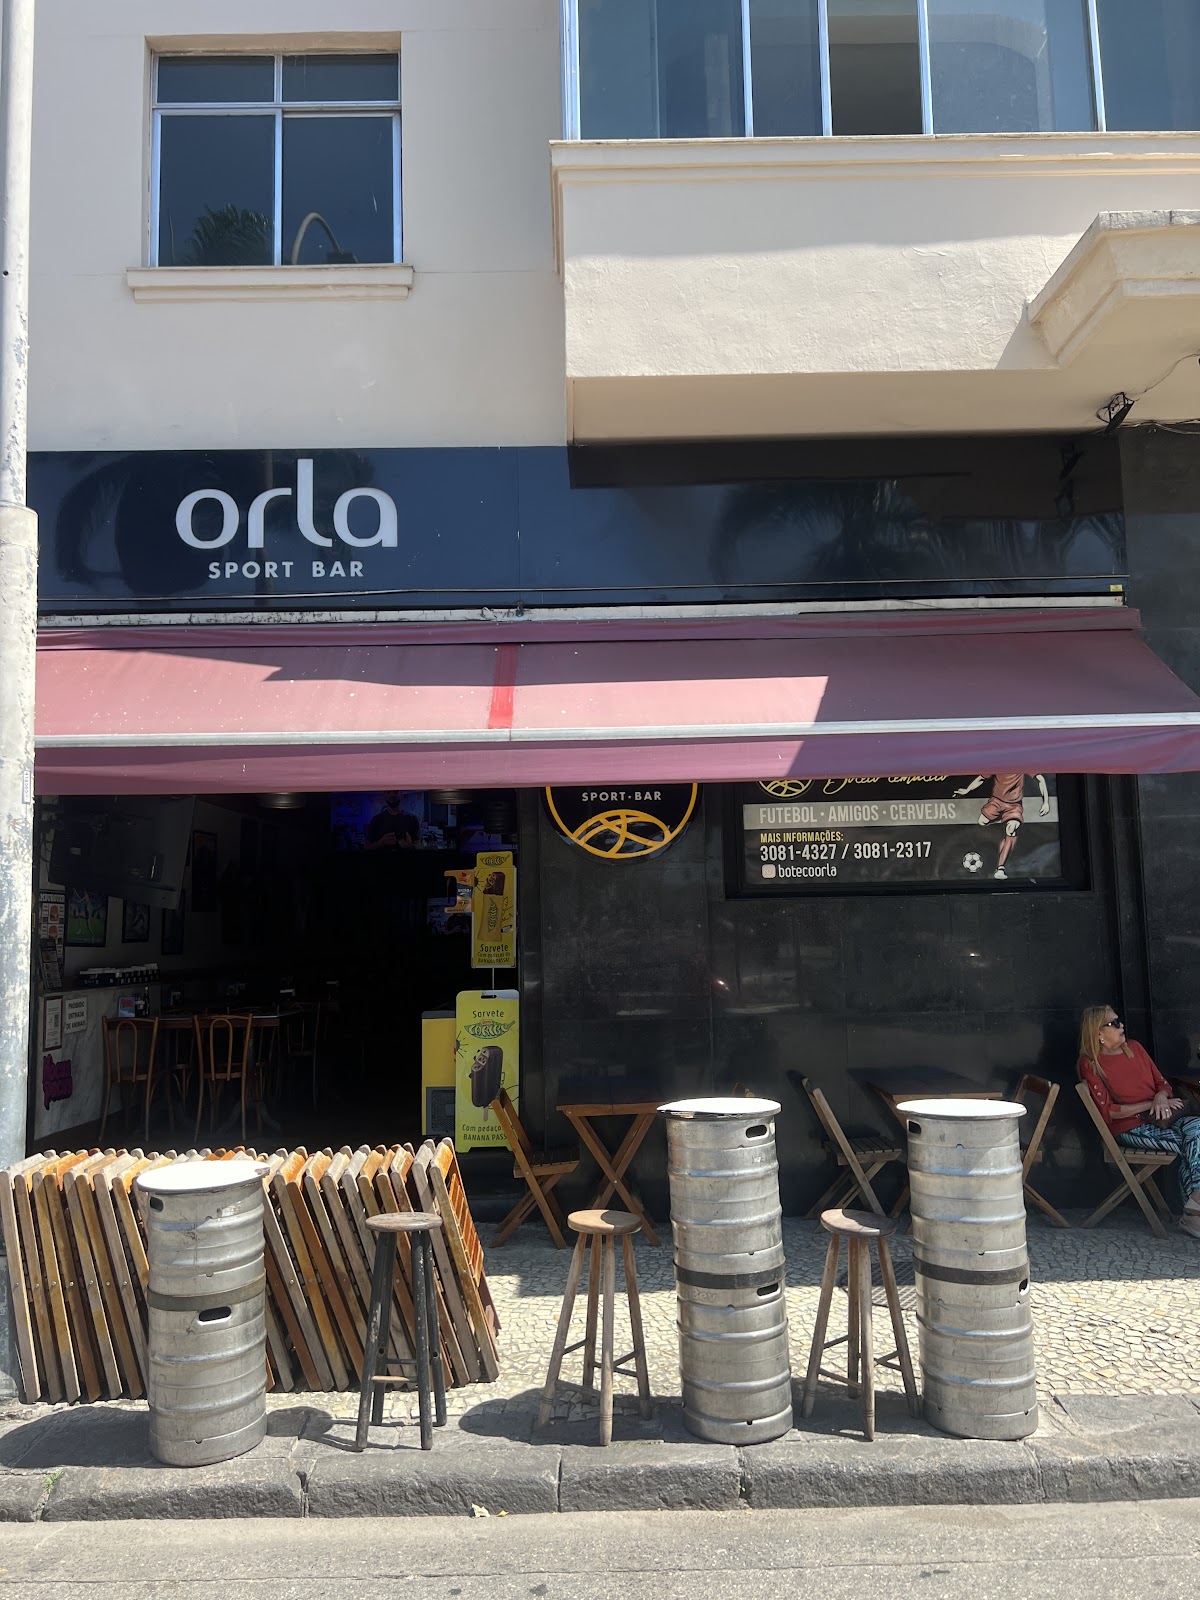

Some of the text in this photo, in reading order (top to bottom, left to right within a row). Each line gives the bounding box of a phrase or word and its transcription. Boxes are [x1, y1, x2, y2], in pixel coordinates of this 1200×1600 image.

[175, 458, 398, 550] orla
[208, 560, 364, 579] SPORT BAR
[581, 790, 662, 802] SPORT BAR
[759, 802, 957, 824] FUTEBOL AMIGOS CERVEJAS
[760, 830, 844, 843] MAIS INFORMAÇÕES:
[760, 843, 837, 861] 3081-4327
[853, 841, 932, 859] 3081-2317
[778, 863, 837, 878] botecoorla
[480, 943, 509, 953] Sorvete
[472, 1009, 505, 1019] Sorvete
[462, 1123, 503, 1133] Com pedaço
[463, 1133, 507, 1141] BANANA PASS
